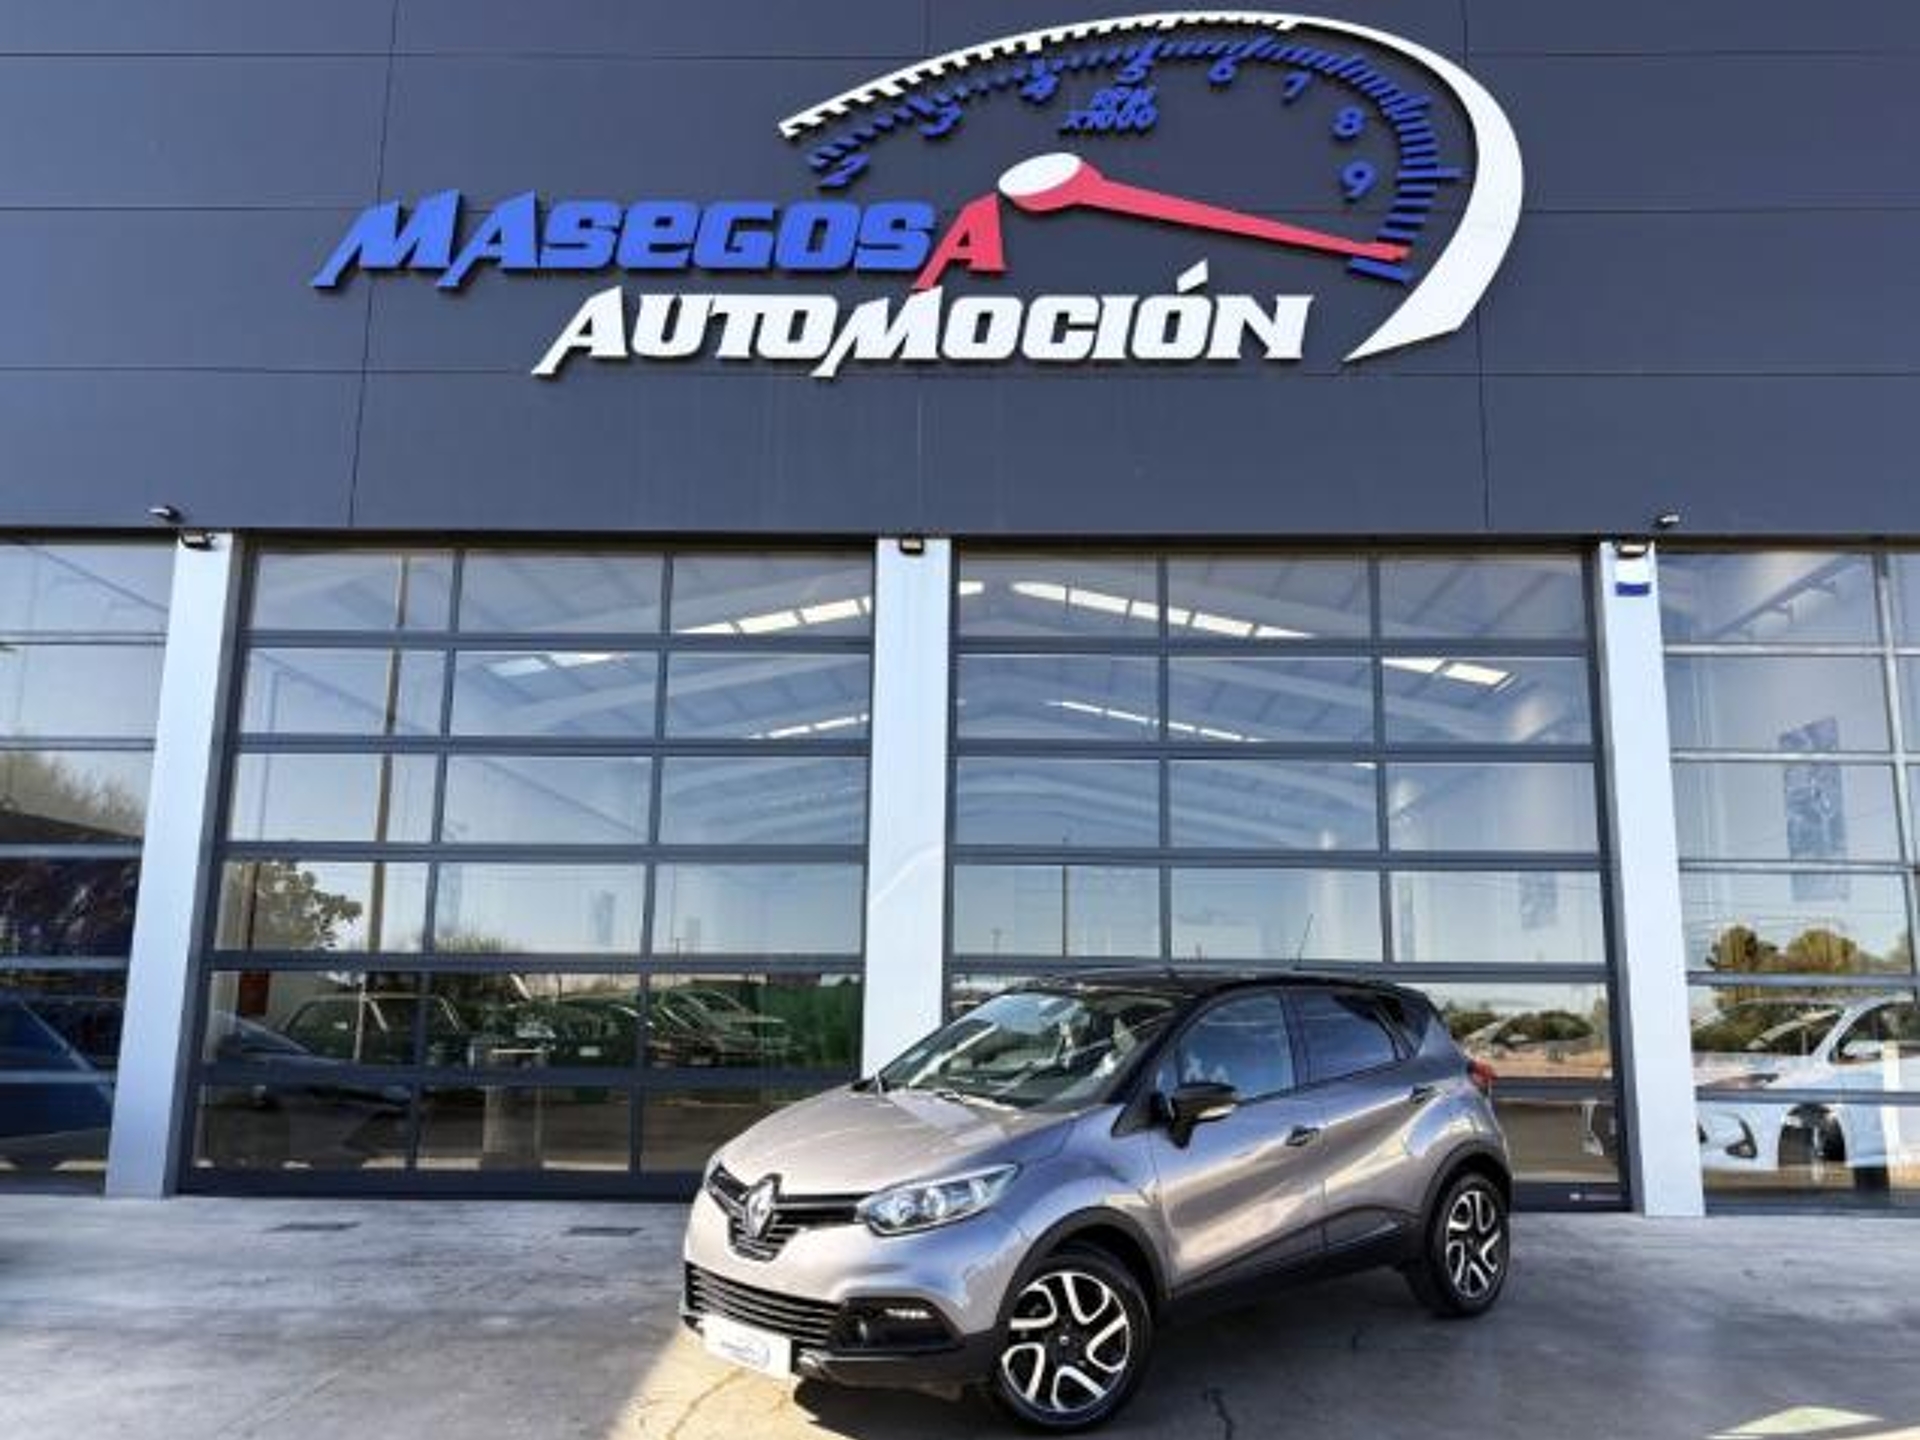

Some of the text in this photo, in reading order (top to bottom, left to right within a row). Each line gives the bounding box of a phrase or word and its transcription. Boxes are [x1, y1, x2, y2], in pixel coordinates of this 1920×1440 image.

[1207, 56, 1236, 83] 6
[1332, 106, 1365, 137] 8
[1341, 161, 1377, 197] 9
[532, 261, 1315, 377] AUTOMOCIÓN
